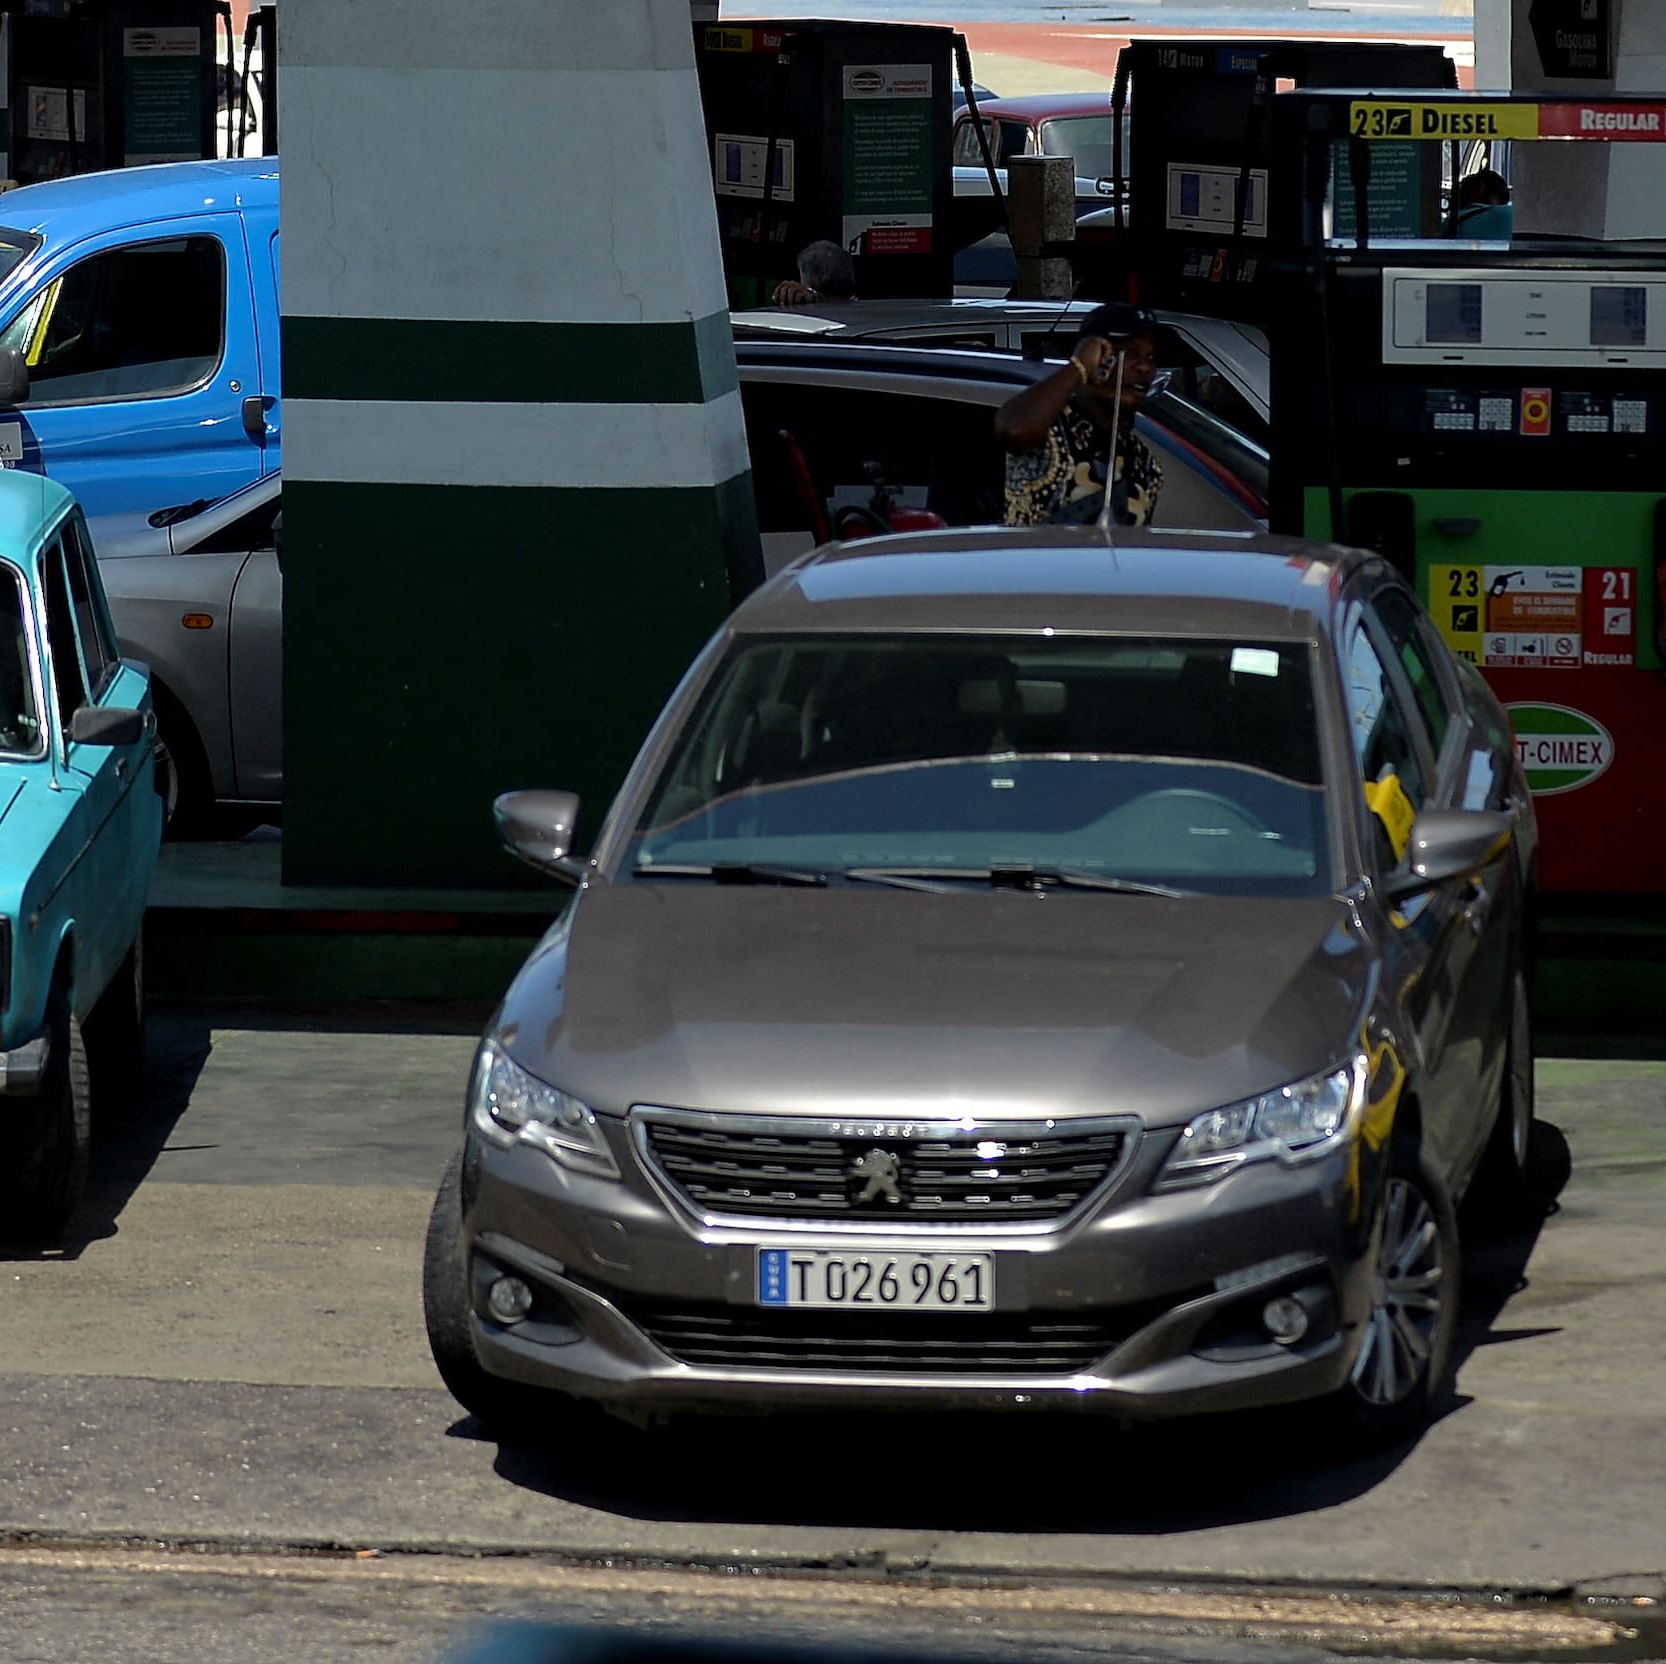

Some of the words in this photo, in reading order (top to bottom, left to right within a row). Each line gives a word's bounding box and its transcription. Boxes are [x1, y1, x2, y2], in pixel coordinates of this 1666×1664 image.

[1355, 109, 1384, 136] 23
[1421, 109, 1498, 135] DIESEL
[1580, 109, 1660, 132] REGULAR
[1449, 569, 1479, 597] 23
[1601, 570, 1631, 601] 21
[1583, 650, 1634, 666] REGULAR
[1517, 740, 1603, 765] T-CIMEX
[791, 1256, 815, 1302] T
[826, 1257, 900, 1303] 026
[911, 1258, 987, 1305] 961
